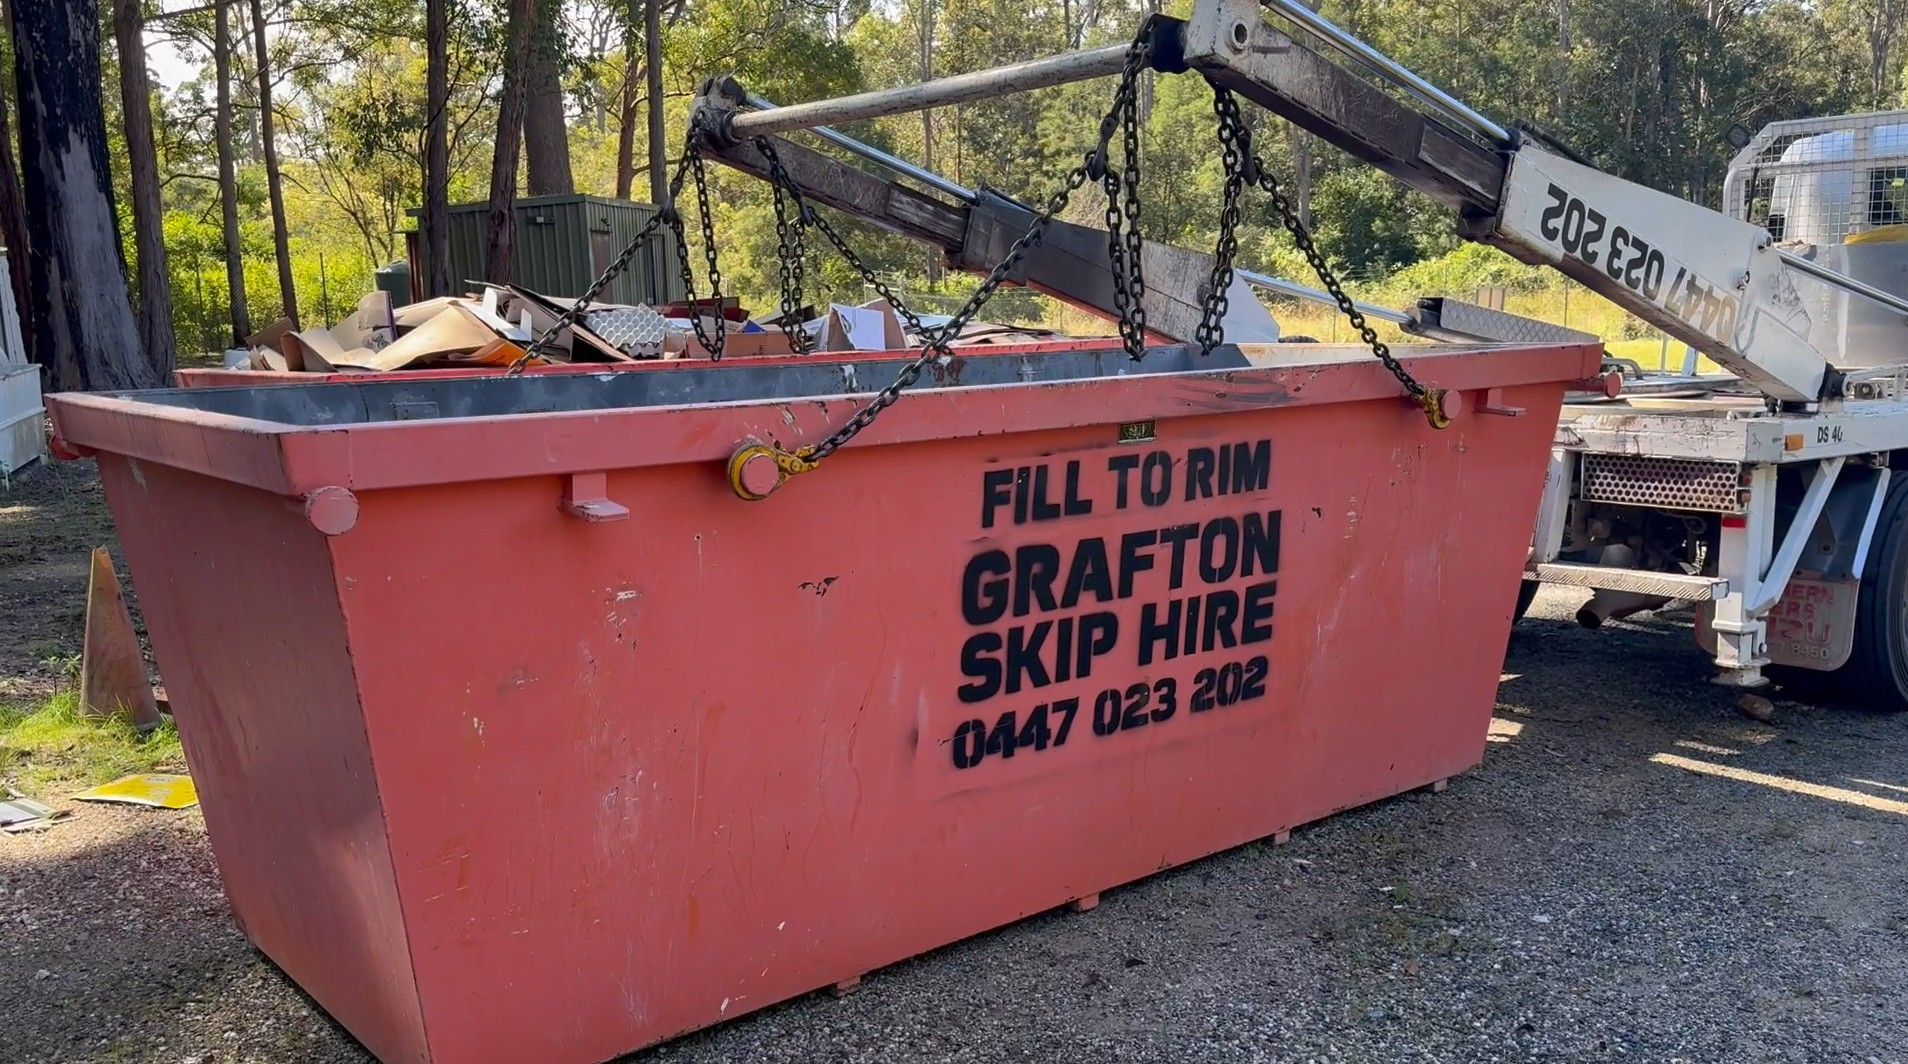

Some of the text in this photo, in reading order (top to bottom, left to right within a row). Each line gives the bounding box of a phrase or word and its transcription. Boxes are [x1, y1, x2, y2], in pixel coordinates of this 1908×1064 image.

[1541, 183, 1606, 265] 202
[1607, 225, 1665, 300] 023
[1663, 266, 1737, 345] 0447
[1817, 426, 1829, 443] DS
[981, 440, 1271, 528] FILL TO RIM
[962, 510, 1281, 626] GRAFTON
[958, 581, 1277, 703] SKIP HIRE
[953, 656, 1268, 771] 0447 023 202
